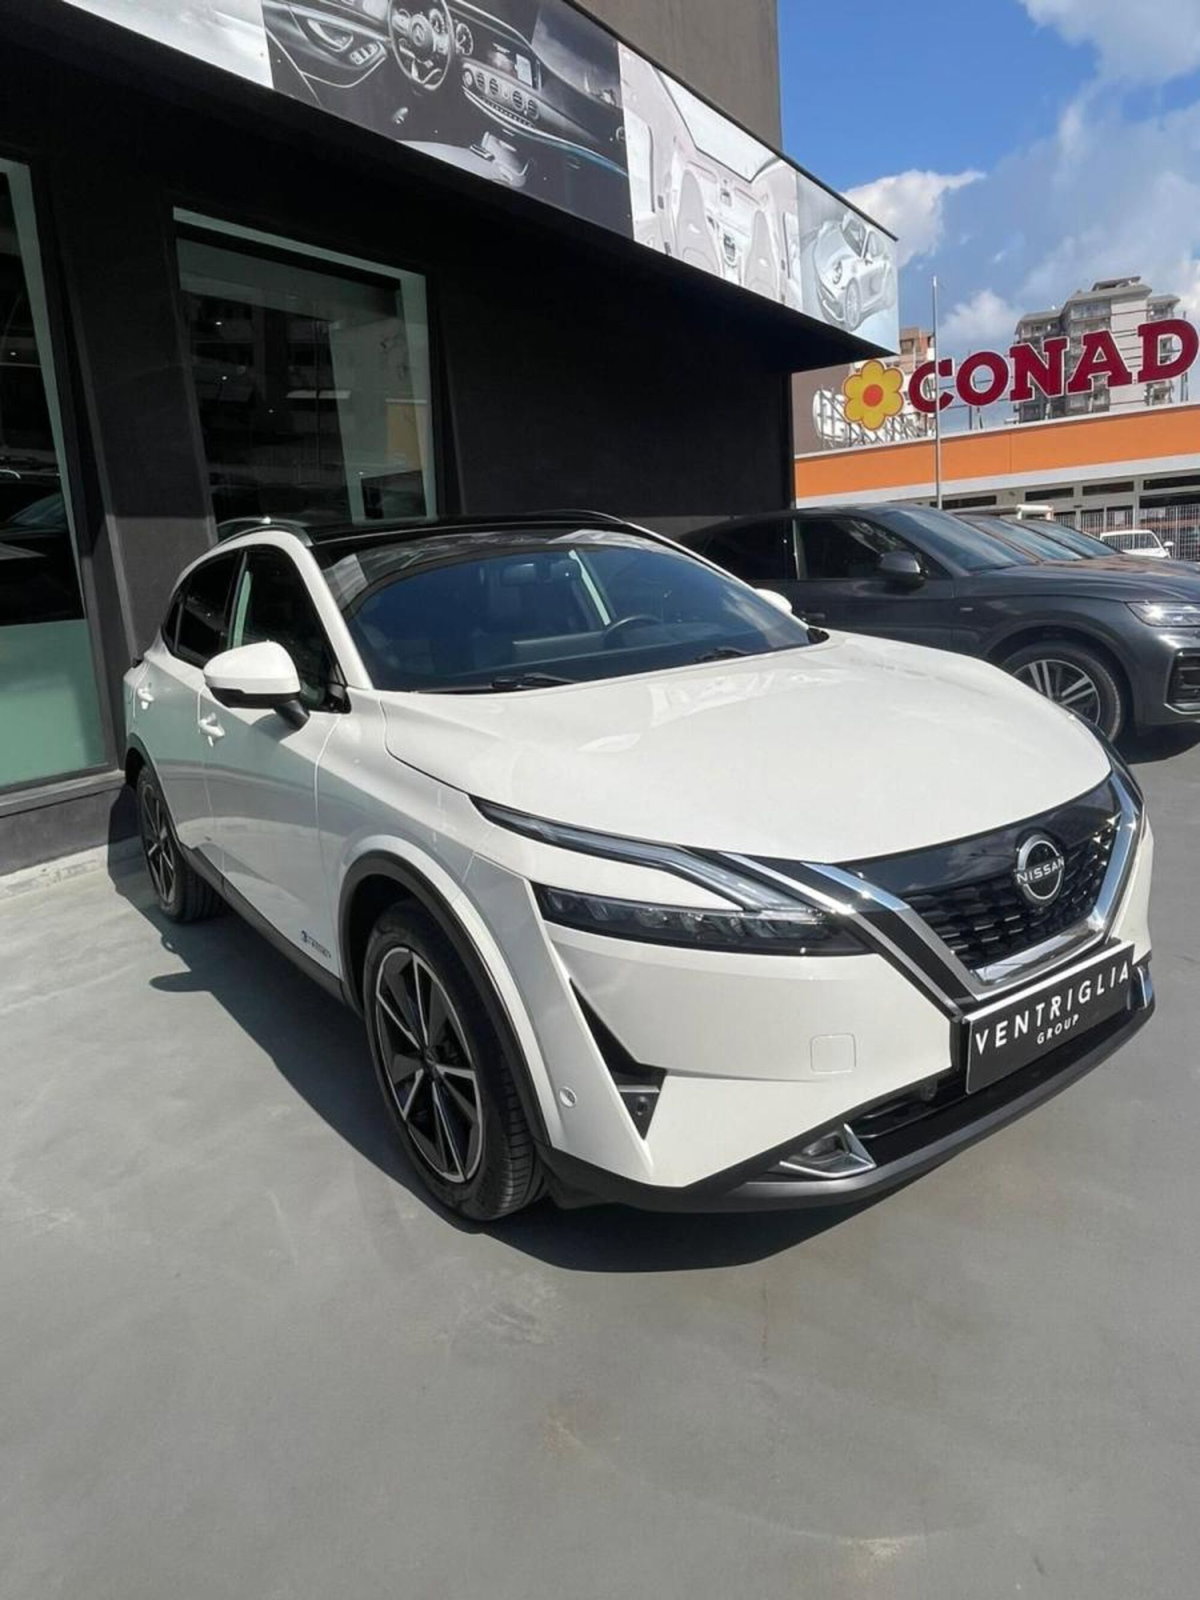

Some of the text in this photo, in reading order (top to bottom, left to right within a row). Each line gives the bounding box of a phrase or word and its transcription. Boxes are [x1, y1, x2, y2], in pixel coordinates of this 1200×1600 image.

[908, 318, 1199, 413] CONAD
[1016, 856, 1065, 884] NISSAN
[975, 961, 1129, 1055] VENTRIGLIA
[1037, 1014, 1079, 1044] GROUP
